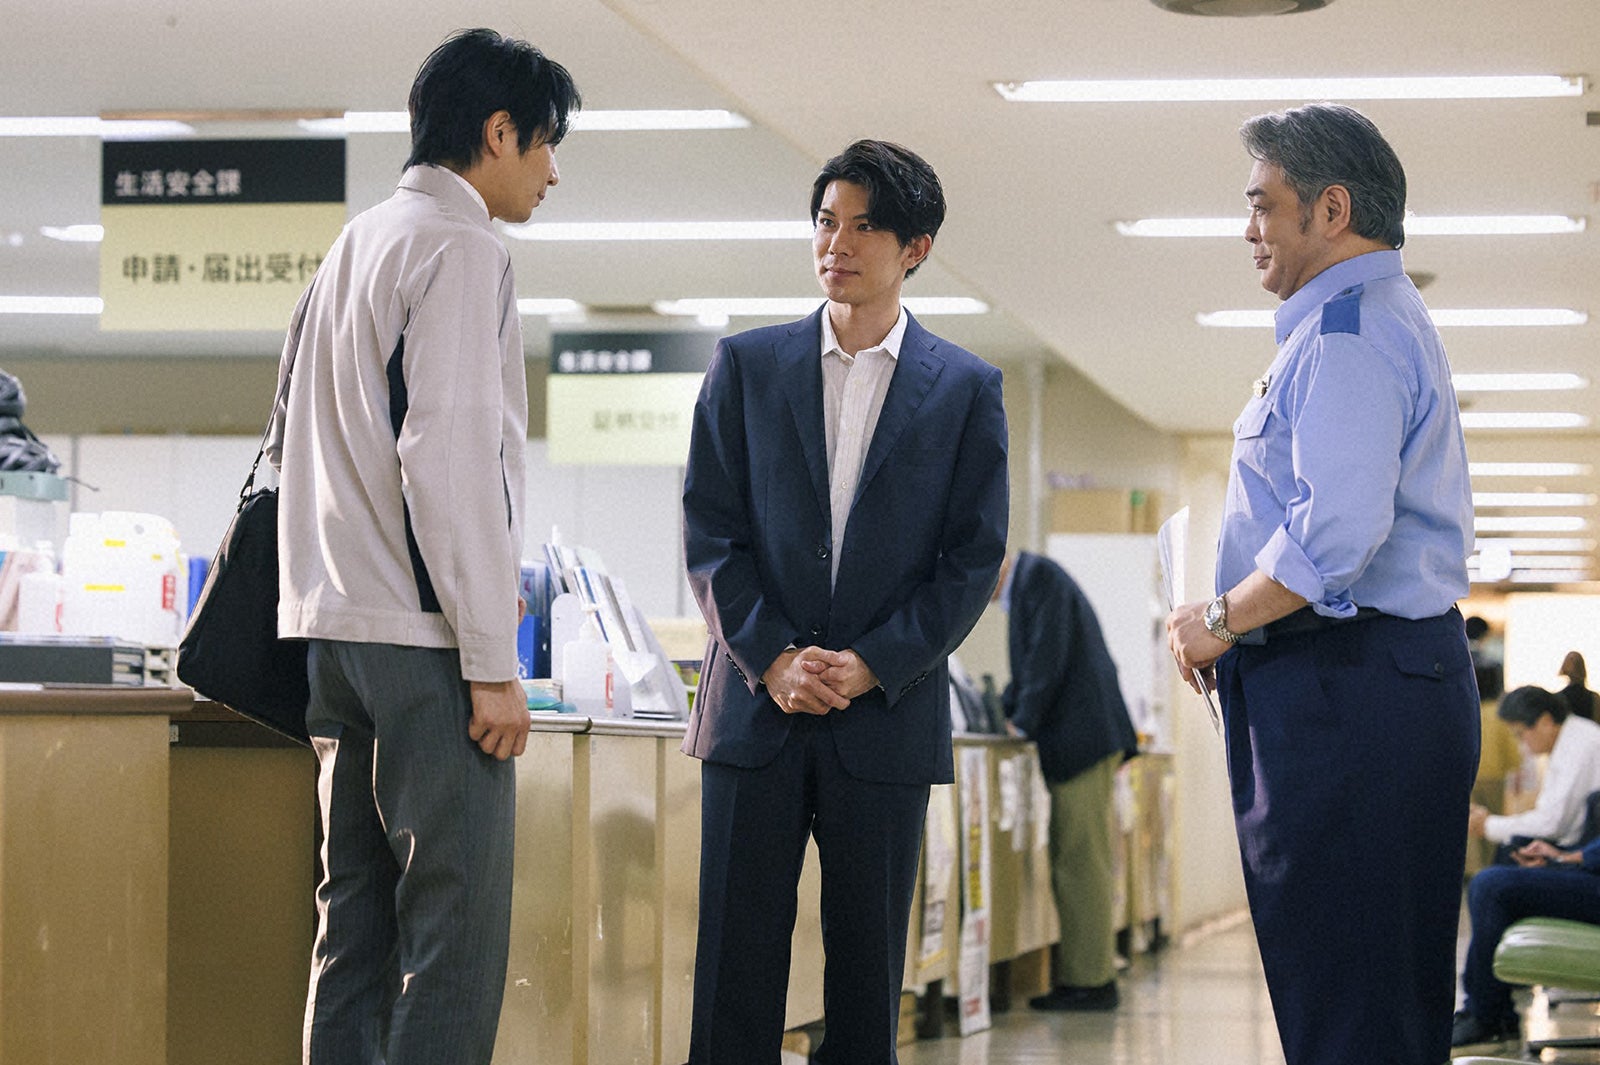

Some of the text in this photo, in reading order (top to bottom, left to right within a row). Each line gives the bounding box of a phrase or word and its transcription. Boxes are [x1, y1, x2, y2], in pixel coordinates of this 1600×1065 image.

[115, 169, 241, 196] 生活安全課
